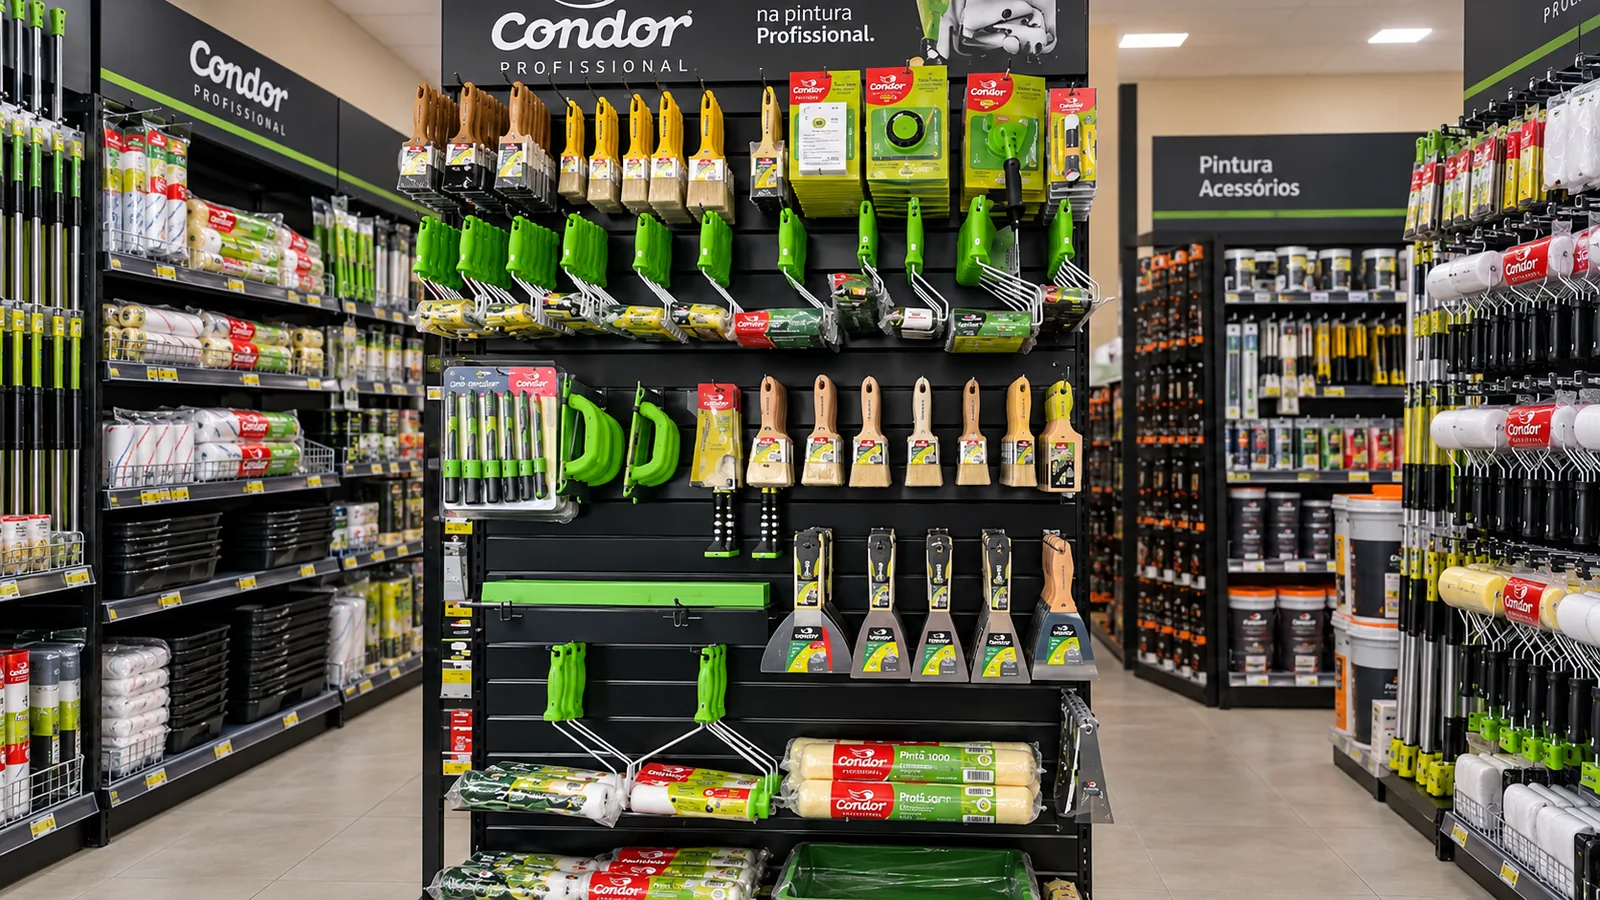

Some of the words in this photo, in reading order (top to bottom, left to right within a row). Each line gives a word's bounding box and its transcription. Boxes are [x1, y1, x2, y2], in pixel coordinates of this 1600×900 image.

[757, 9, 779, 22] na
[784, 5, 852, 26] pintura
[491, 9, 693, 51] Condor
[757, 25, 876, 45] Profissional.
[500, 59, 688, 75] PROFISSIONAL
[189, 40, 289, 113] Condor
[793, 86, 825, 94] Condor
[869, 82, 906, 91] Condor
[970, 87, 1006, 96] Condor
[194, 84, 287, 137] PROFISSIONAL
[1199, 155, 1273, 174] Pintura
[1199, 178, 1300, 197] Acessórios
[1505, 257, 1539, 276] Condor
[1507, 423, 1541, 436] Condor
[838, 756, 887, 767] Condor
[928, 753, 950, 761] 1000
[836, 799, 887, 811] Condor
[593, 883, 643, 896] Condor
